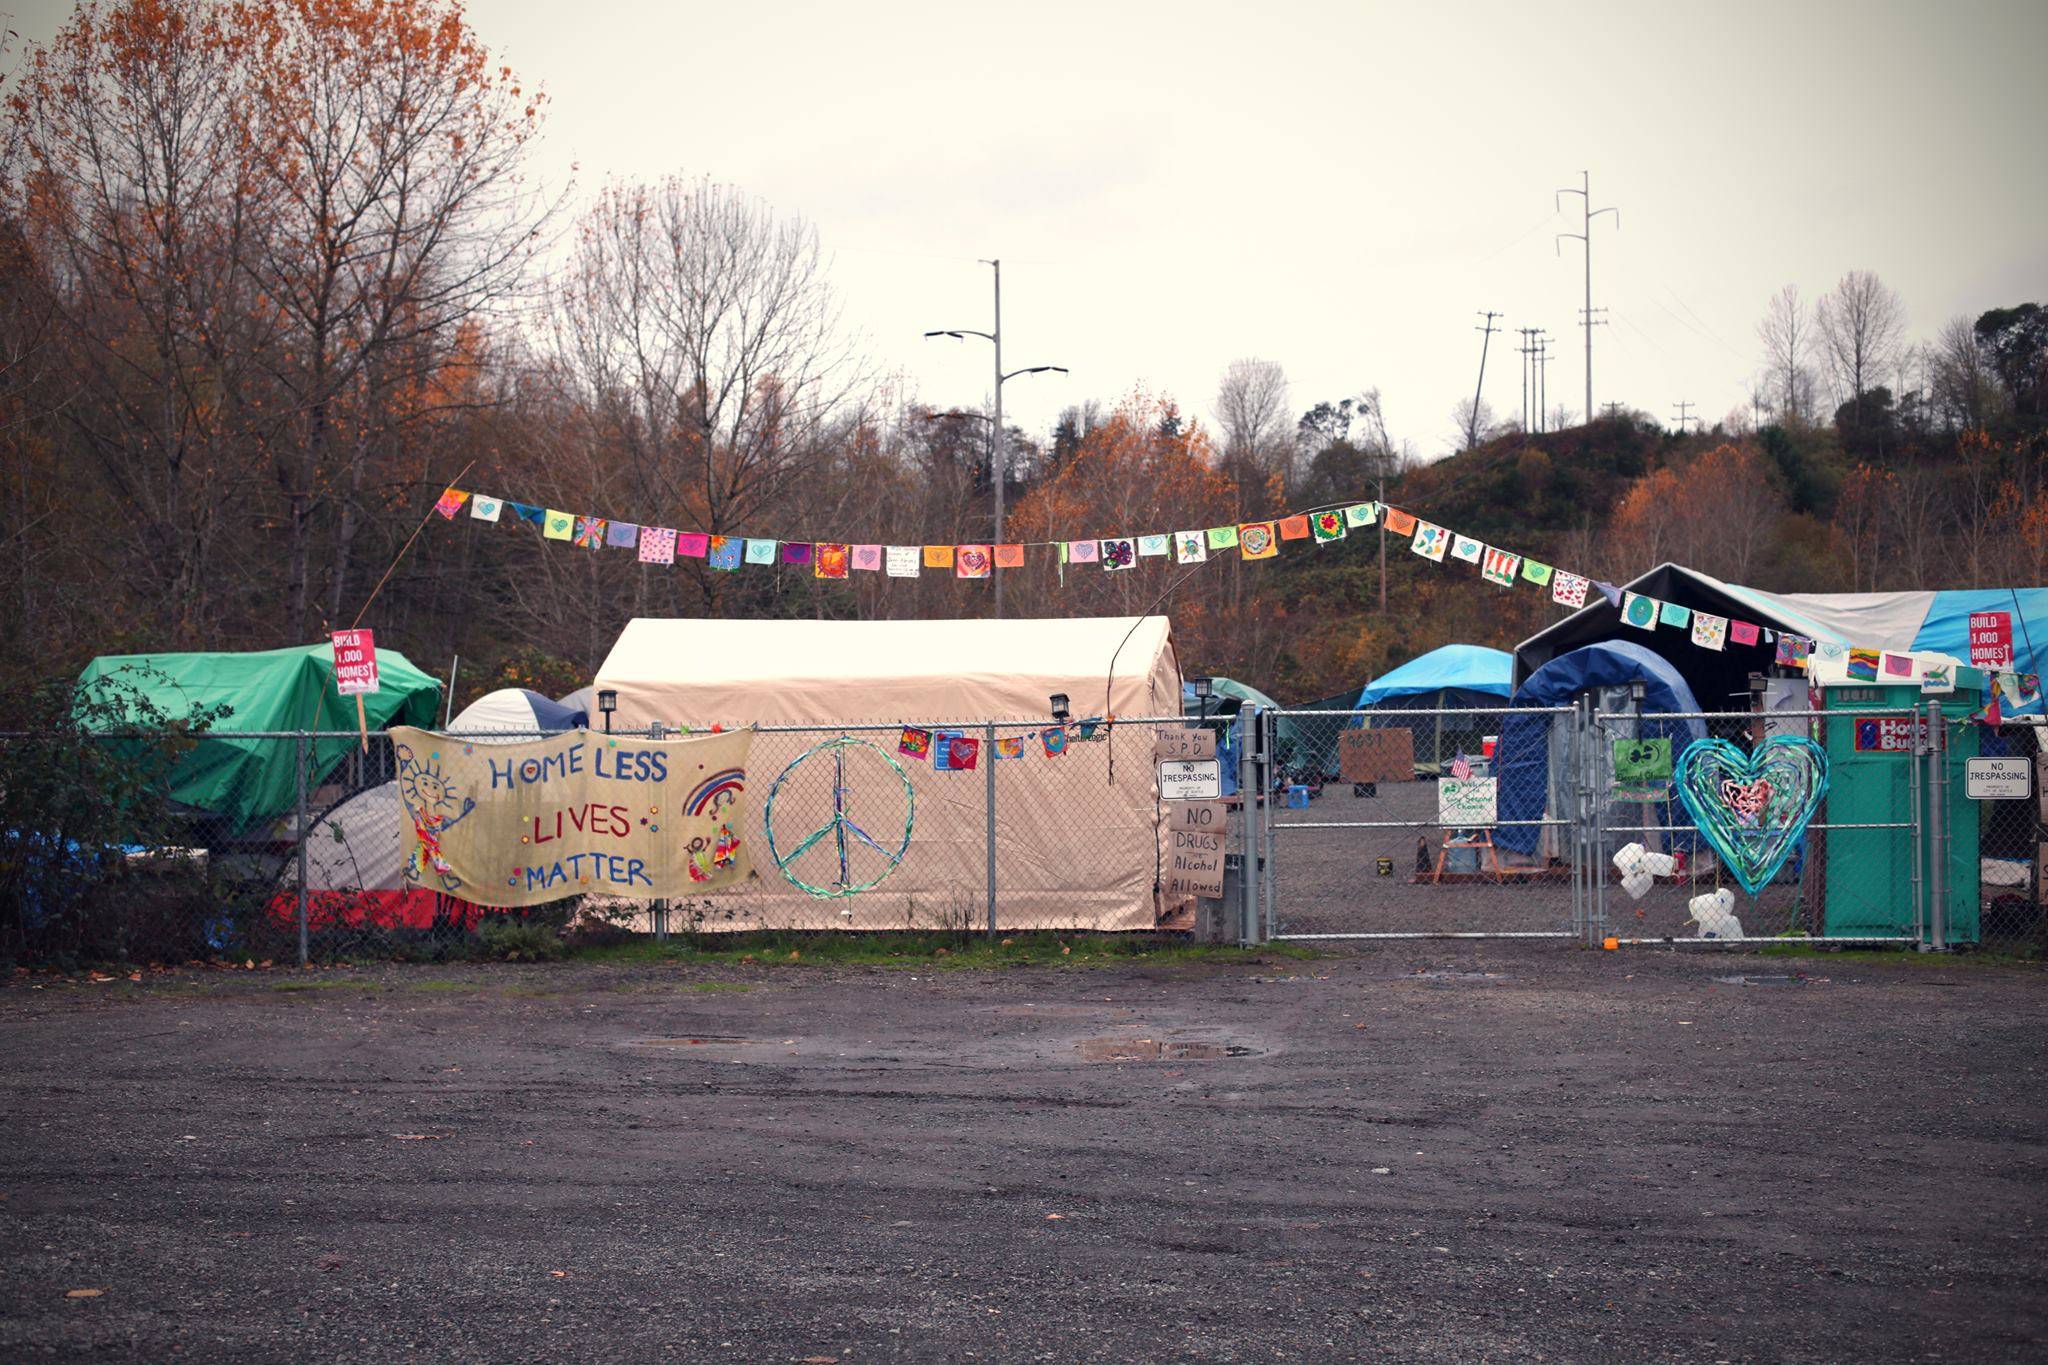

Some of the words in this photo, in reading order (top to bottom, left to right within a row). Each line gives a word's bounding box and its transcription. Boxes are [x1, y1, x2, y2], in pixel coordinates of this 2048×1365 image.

[1970, 616, 1997, 628] BUILD
[1972, 632, 1998, 645] 1,000
[1157, 730, 1185, 741] Thank
[1183, 764, 1195, 772] NO
[1991, 763, 2004, 771] NO
[534, 803, 631, 844] LIVES
[1187, 808, 1213, 826] NO
[1176, 831, 1219, 851] DRUGS
[1174, 856, 1218, 872] Alcohol
[526, 852, 653, 891] MATTER
[1170, 879, 1222, 893] Allowed
